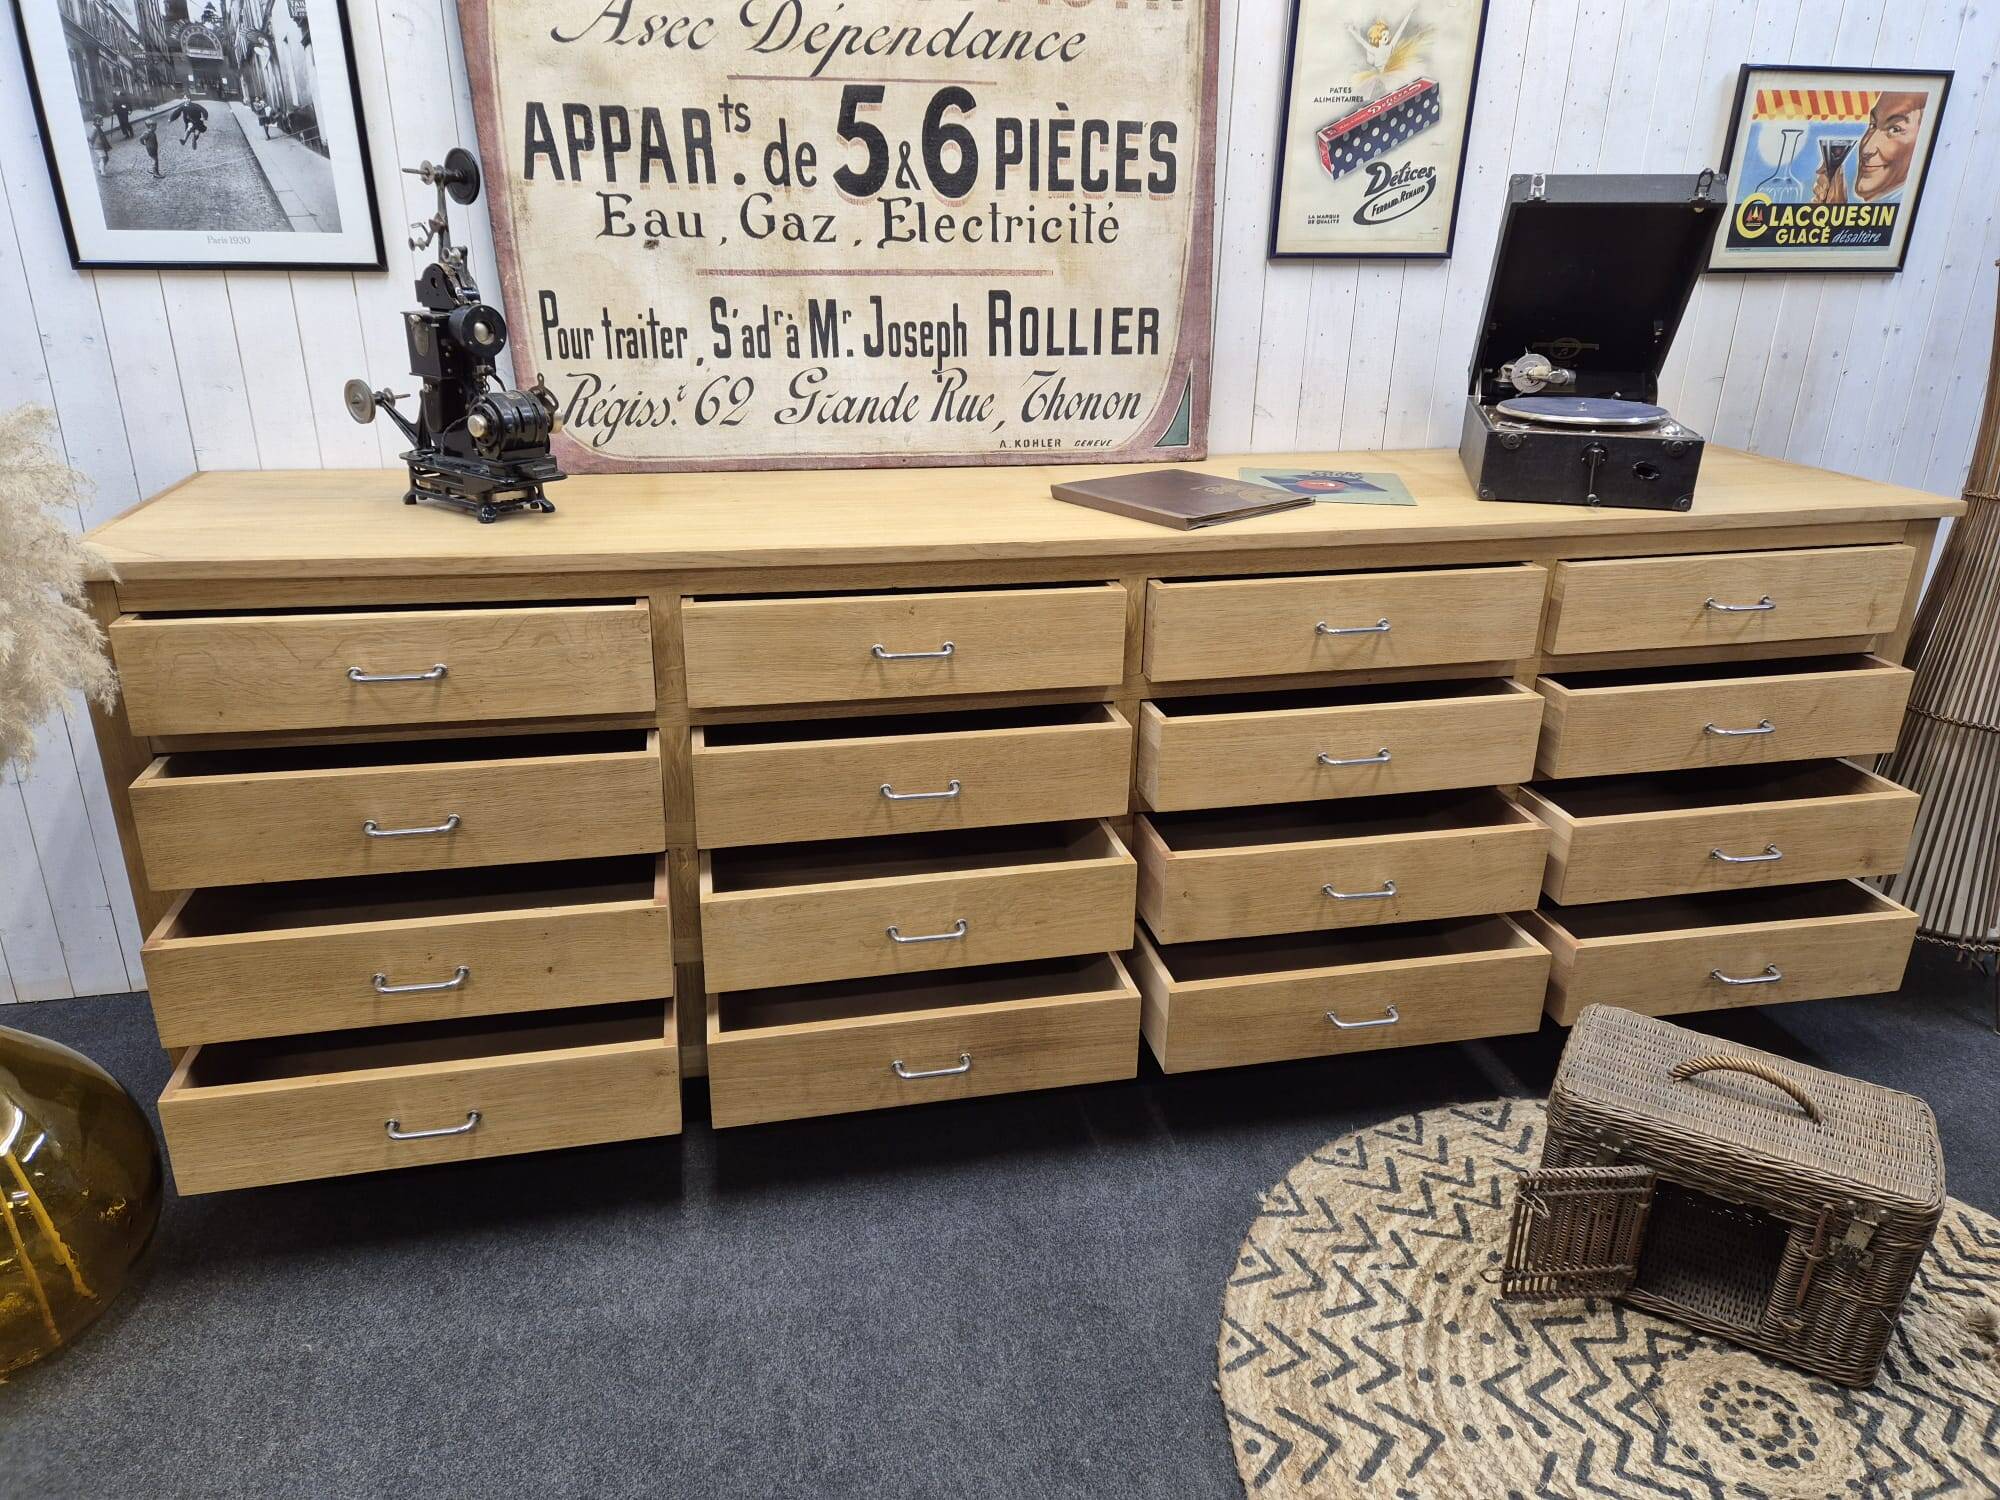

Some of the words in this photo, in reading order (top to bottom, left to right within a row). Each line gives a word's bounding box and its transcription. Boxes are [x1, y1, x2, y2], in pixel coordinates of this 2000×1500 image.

[740, 0, 1087, 77] Dépendance
[763, 117, 818, 188] de
[995, 102, 1178, 194] PIÈCES
[1364, 160, 1436, 197] Délices
[876, 196, 1120, 249] Electricité
[1736, 192, 1896, 239] CLACQUESIN
[1775, 226, 1831, 244] GLACÉ
[1832, 230, 1882, 243] désaltère
[538, 289, 594, 361] Pour
[863, 295, 967, 383] Joseph
[988, 289, 1160, 357] ROLLIER
[694, 374, 754, 426] 62
[1020, 366, 1142, 423] Thonon
